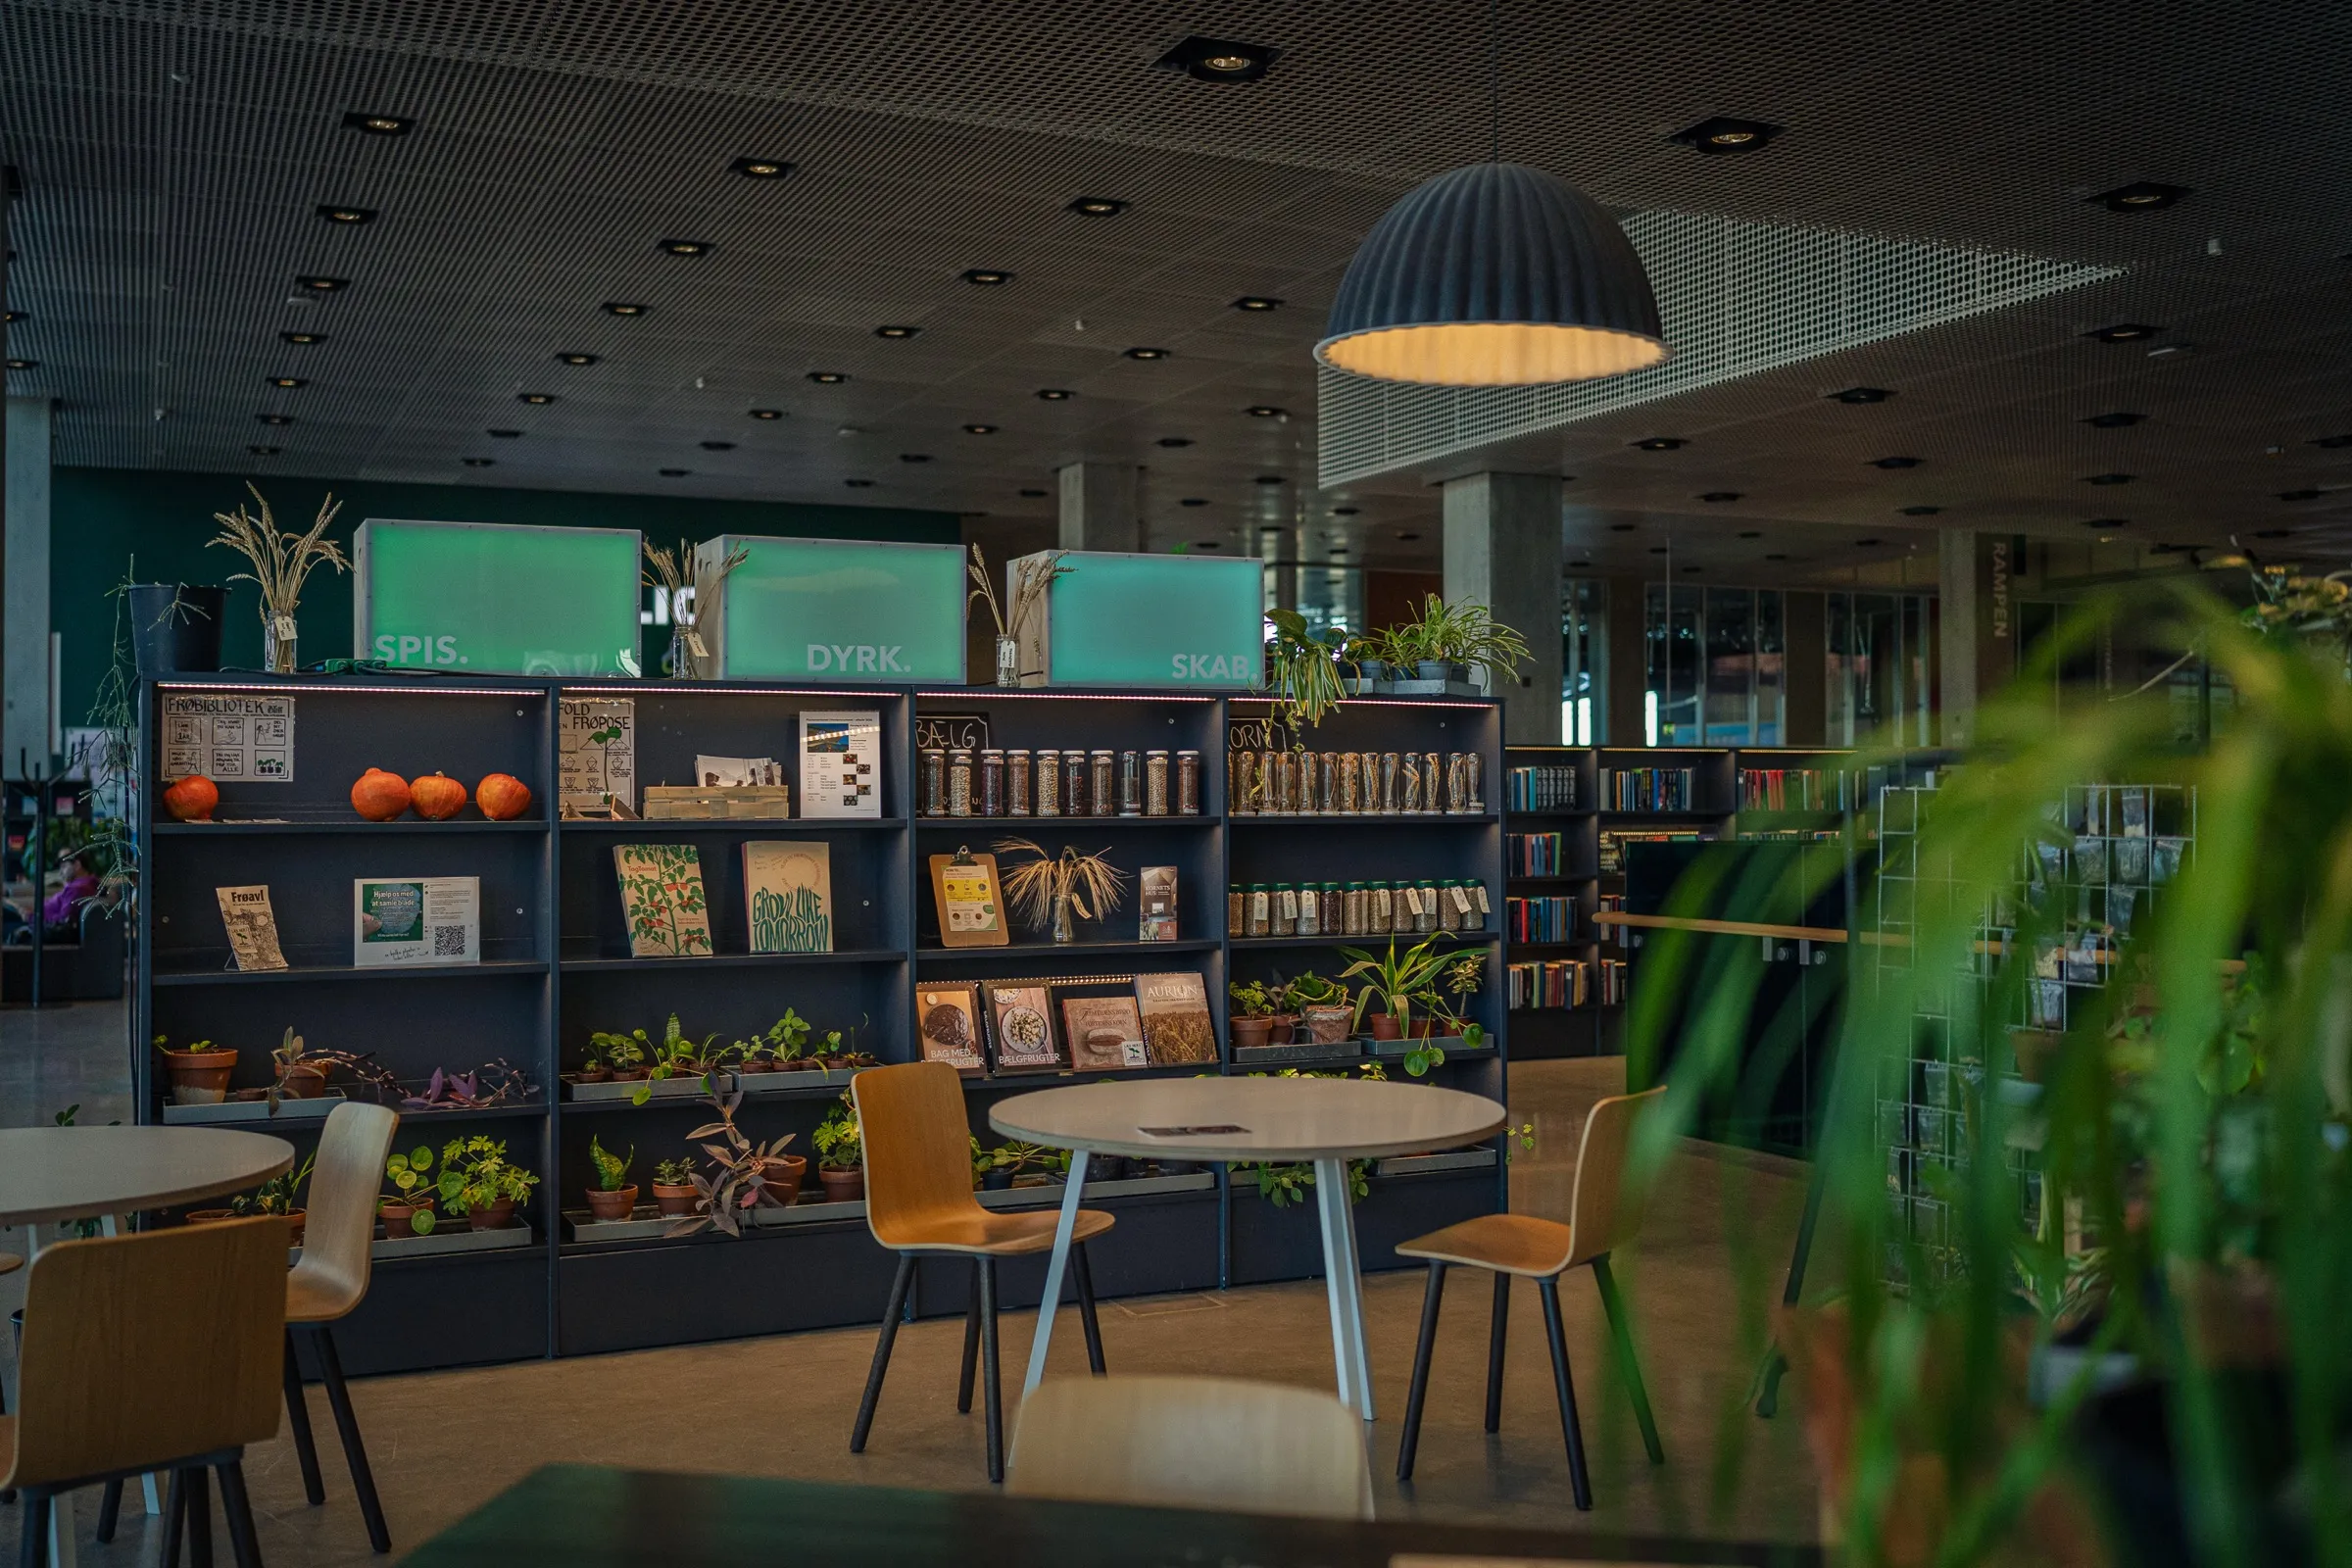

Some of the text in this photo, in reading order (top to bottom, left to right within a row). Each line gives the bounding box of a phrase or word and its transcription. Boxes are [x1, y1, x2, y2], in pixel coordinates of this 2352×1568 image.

[1992, 542, 2008, 637] RAMPEN
[374, 635, 468, 664] SPIS.
[808, 644, 911, 672] DYRK.
[1172, 654, 1258, 680] SKAB.
[169, 697, 265, 714] FRØBIBLIOTEK
[572, 716, 631, 729] FRØPOSE
[1228, 724, 1273, 750] ORN
[231, 889, 265, 903] Frøavl
[753, 882, 822, 924] GROW LIKE
[753, 913, 829, 952] TOMORROW
[1148, 984, 1198, 998] AURION
[931, 1049, 971, 1058] BAG MED
[999, 1053, 1061, 1064] BÆLGFRUGTER
